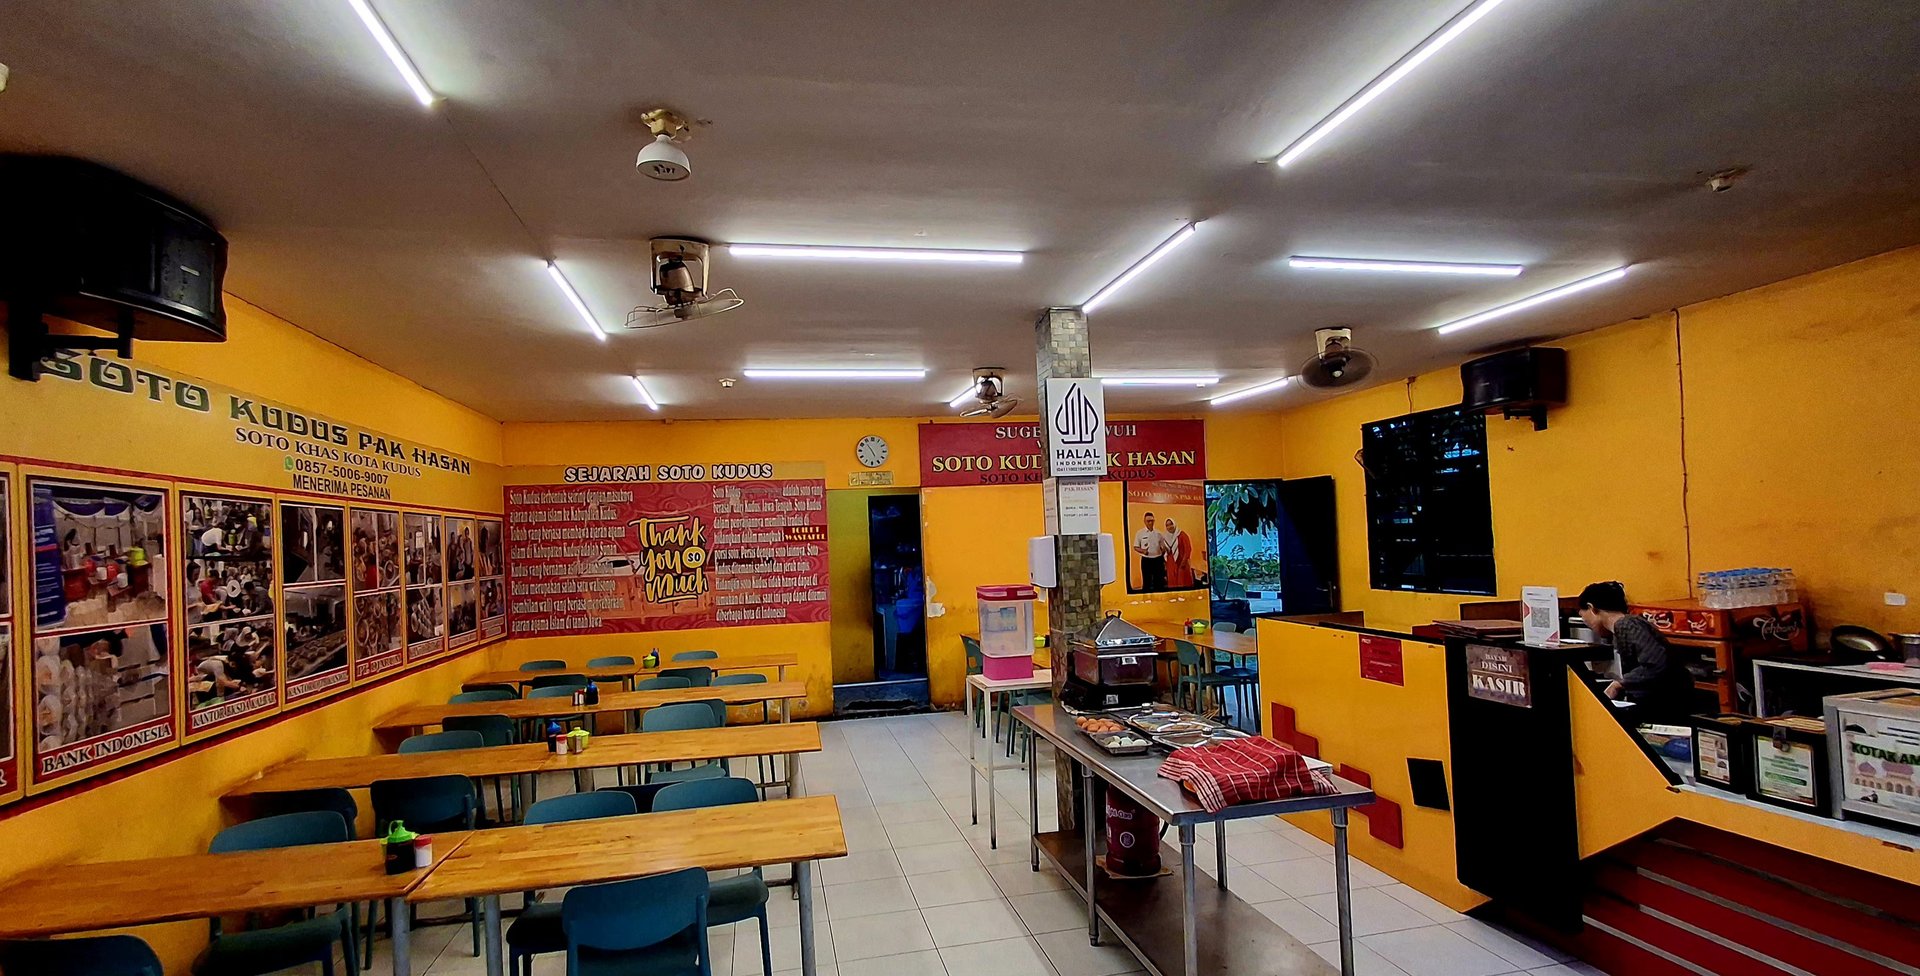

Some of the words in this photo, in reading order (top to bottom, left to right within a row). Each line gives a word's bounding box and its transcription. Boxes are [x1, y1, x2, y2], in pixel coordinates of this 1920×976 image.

[40, 348, 210, 413] SOTO
[229, 394, 349, 446] KUDUS
[358, 431, 407, 462] PAK
[411, 446, 472, 476] HASAN
[995, 426, 1041, 439] SUGE
[236, 427, 290, 451] SOTO
[295, 440, 339, 461] KHAS
[343, 450, 379, 470] KOTA
[382, 460, 422, 478] KUDUS
[932, 455, 994, 473] SOTO
[1127, 449, 1197, 467] HASAN
[1056, 448, 1101, 460] HALAL
[295, 458, 390, 485] 0857-5006-9007
[564, 464, 650, 482] SEJARAH
[657, 463, 705, 480] SOTO
[712, 463, 773, 479] KUDUS
[980, 472, 1020, 484] SOTO
[1108, 468, 1157, 481] KUDUS
[292, 473, 349, 495] MENERIMA
[350, 482, 391, 500] PESANAN
[628, 515, 706, 548] Thank
[791, 526, 821, 534] TOILET
[1481, 661, 1513, 673] DISINI
[1471, 673, 1527, 698] KASIR
[192, 705, 226, 730] KANTOR
[41, 746, 95, 776] BANK
[94, 722, 173, 760] INDONESIA
[1851, 740, 1899, 764] KOTAK
[1900, 752, 1920, 767] AM
